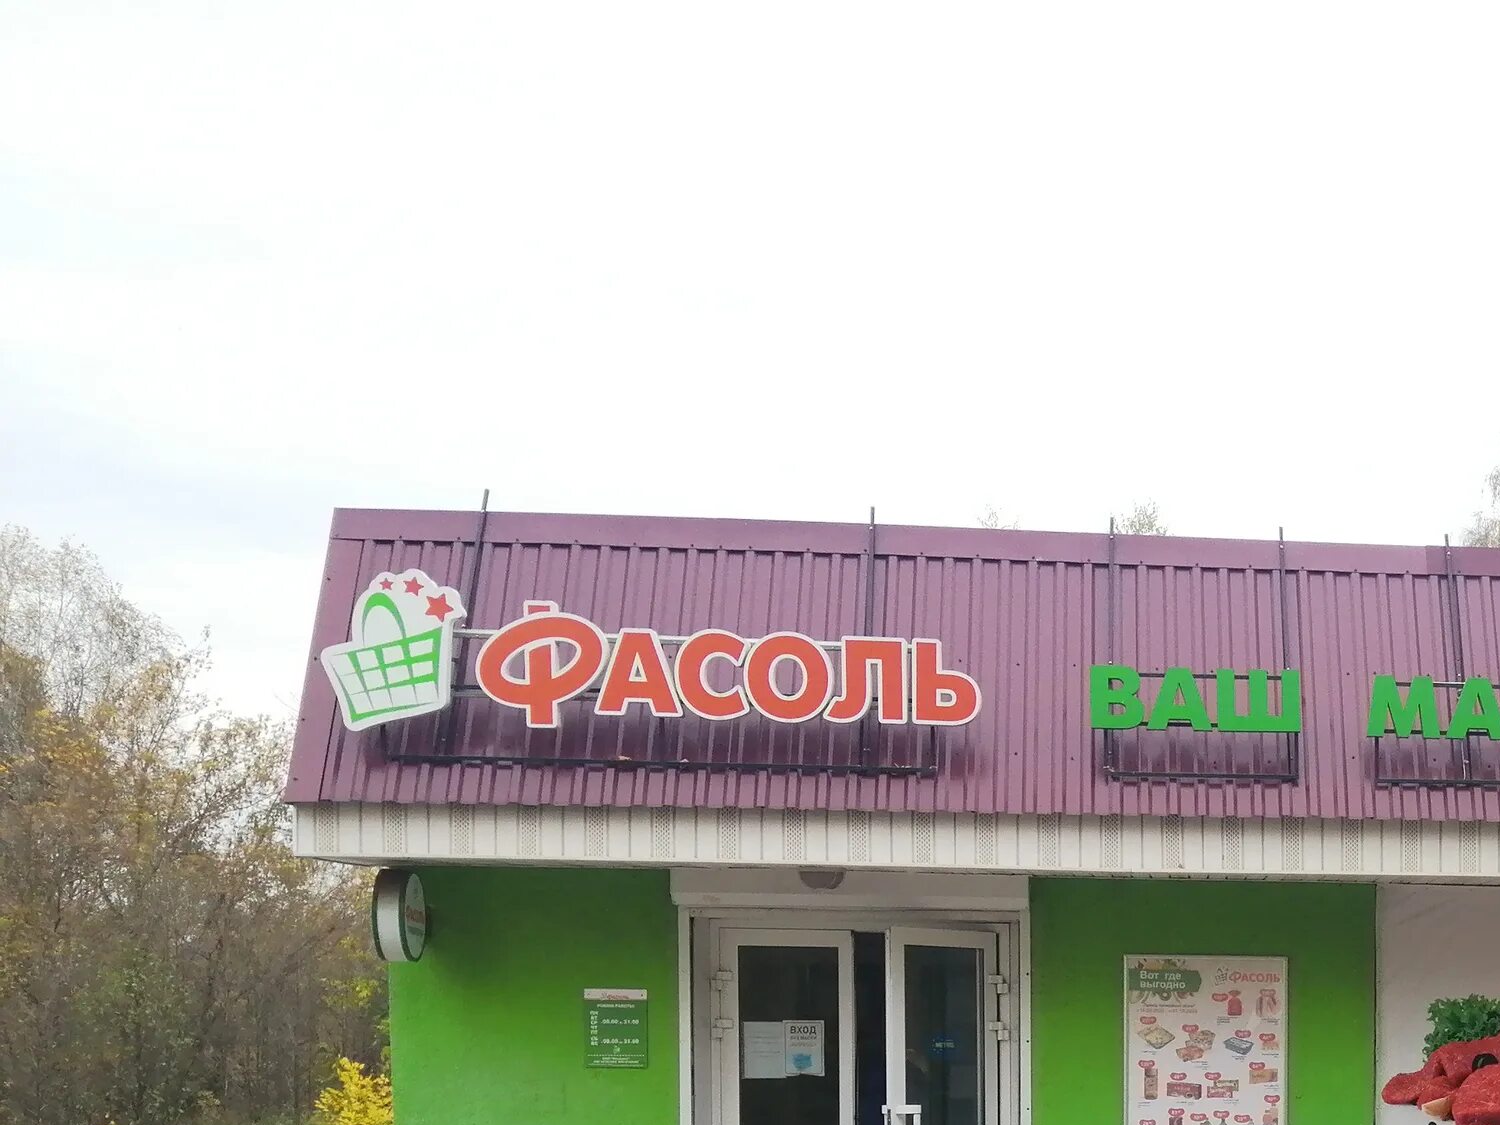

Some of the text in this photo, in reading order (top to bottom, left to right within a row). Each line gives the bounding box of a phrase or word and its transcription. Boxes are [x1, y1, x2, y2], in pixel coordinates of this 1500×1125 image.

[478, 602, 979, 726] ФАСОЛЬ
[1090, 665, 1300, 733] ВАШ
[1140, 970, 1182, 981] Вот где
[1229, 971, 1280, 983] ФАСОЛЬ
[1140, 981, 1186, 990] выгодно
[790, 1026, 816, 1035] ВХОД
